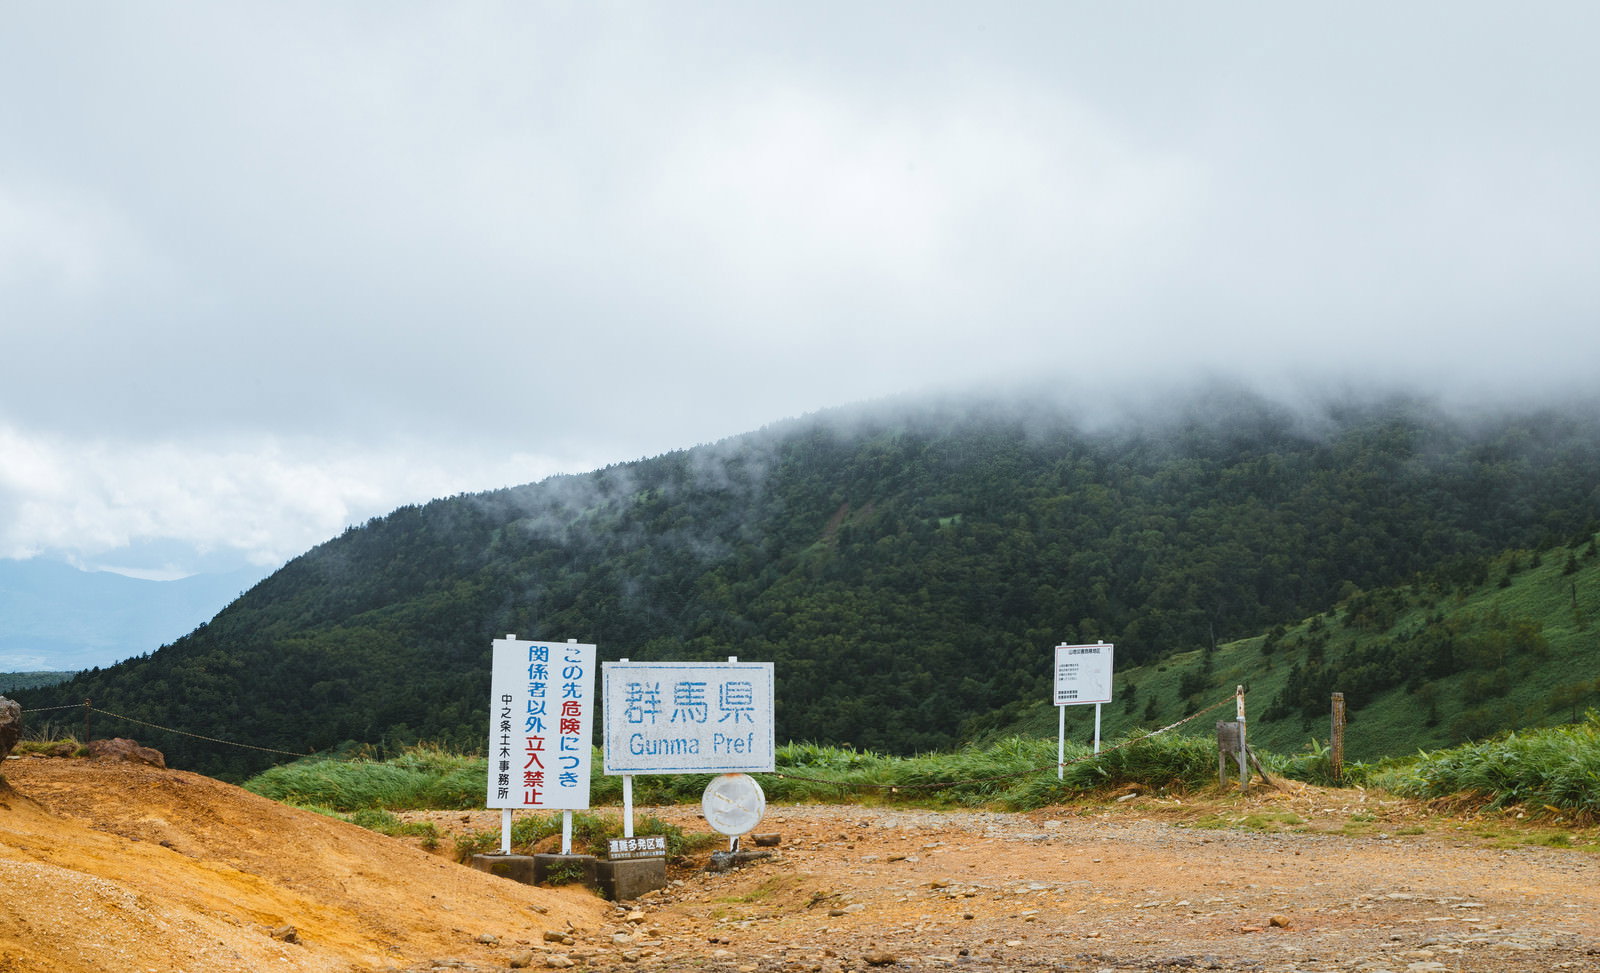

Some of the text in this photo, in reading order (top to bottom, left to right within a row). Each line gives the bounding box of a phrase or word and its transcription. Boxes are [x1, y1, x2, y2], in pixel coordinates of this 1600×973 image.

[497, 693, 513, 800] 中之条土木事務所
[522, 645, 549, 805] 関係者以外立入禁止
[558, 647, 583, 788] この先危険につき
[624, 681, 755, 724] 群馬県
[629, 732, 754, 756] Gunma Pref
